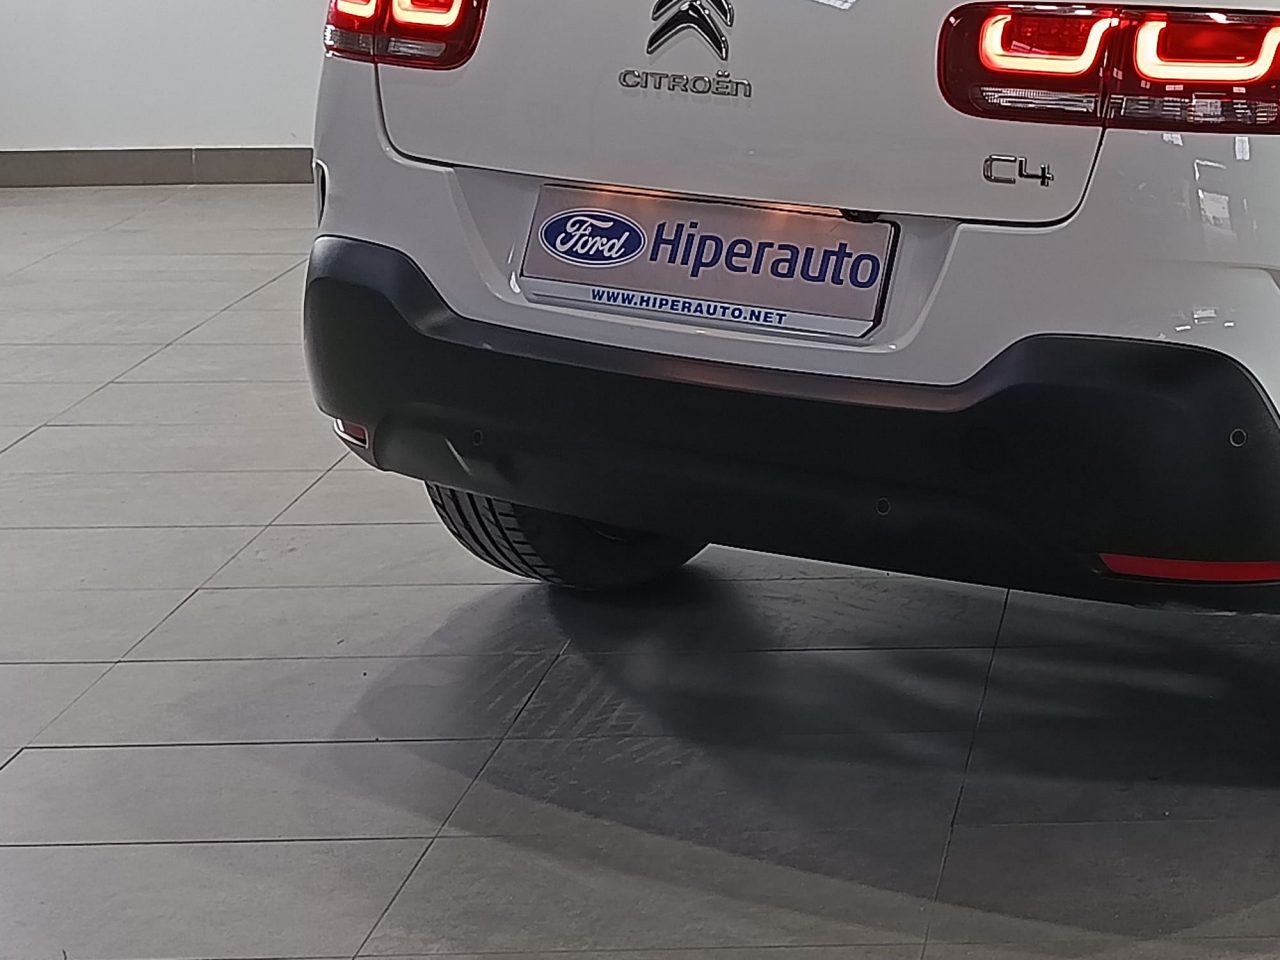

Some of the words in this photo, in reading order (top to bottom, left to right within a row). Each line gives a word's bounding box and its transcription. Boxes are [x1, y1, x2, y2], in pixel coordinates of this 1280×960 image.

[982, 154, 1054, 187] C4
[555, 215, 628, 259] Ford
[648, 221, 881, 289] Hiperauto
[591, 288, 787, 325] WWW.HIPERAUTO.NET
